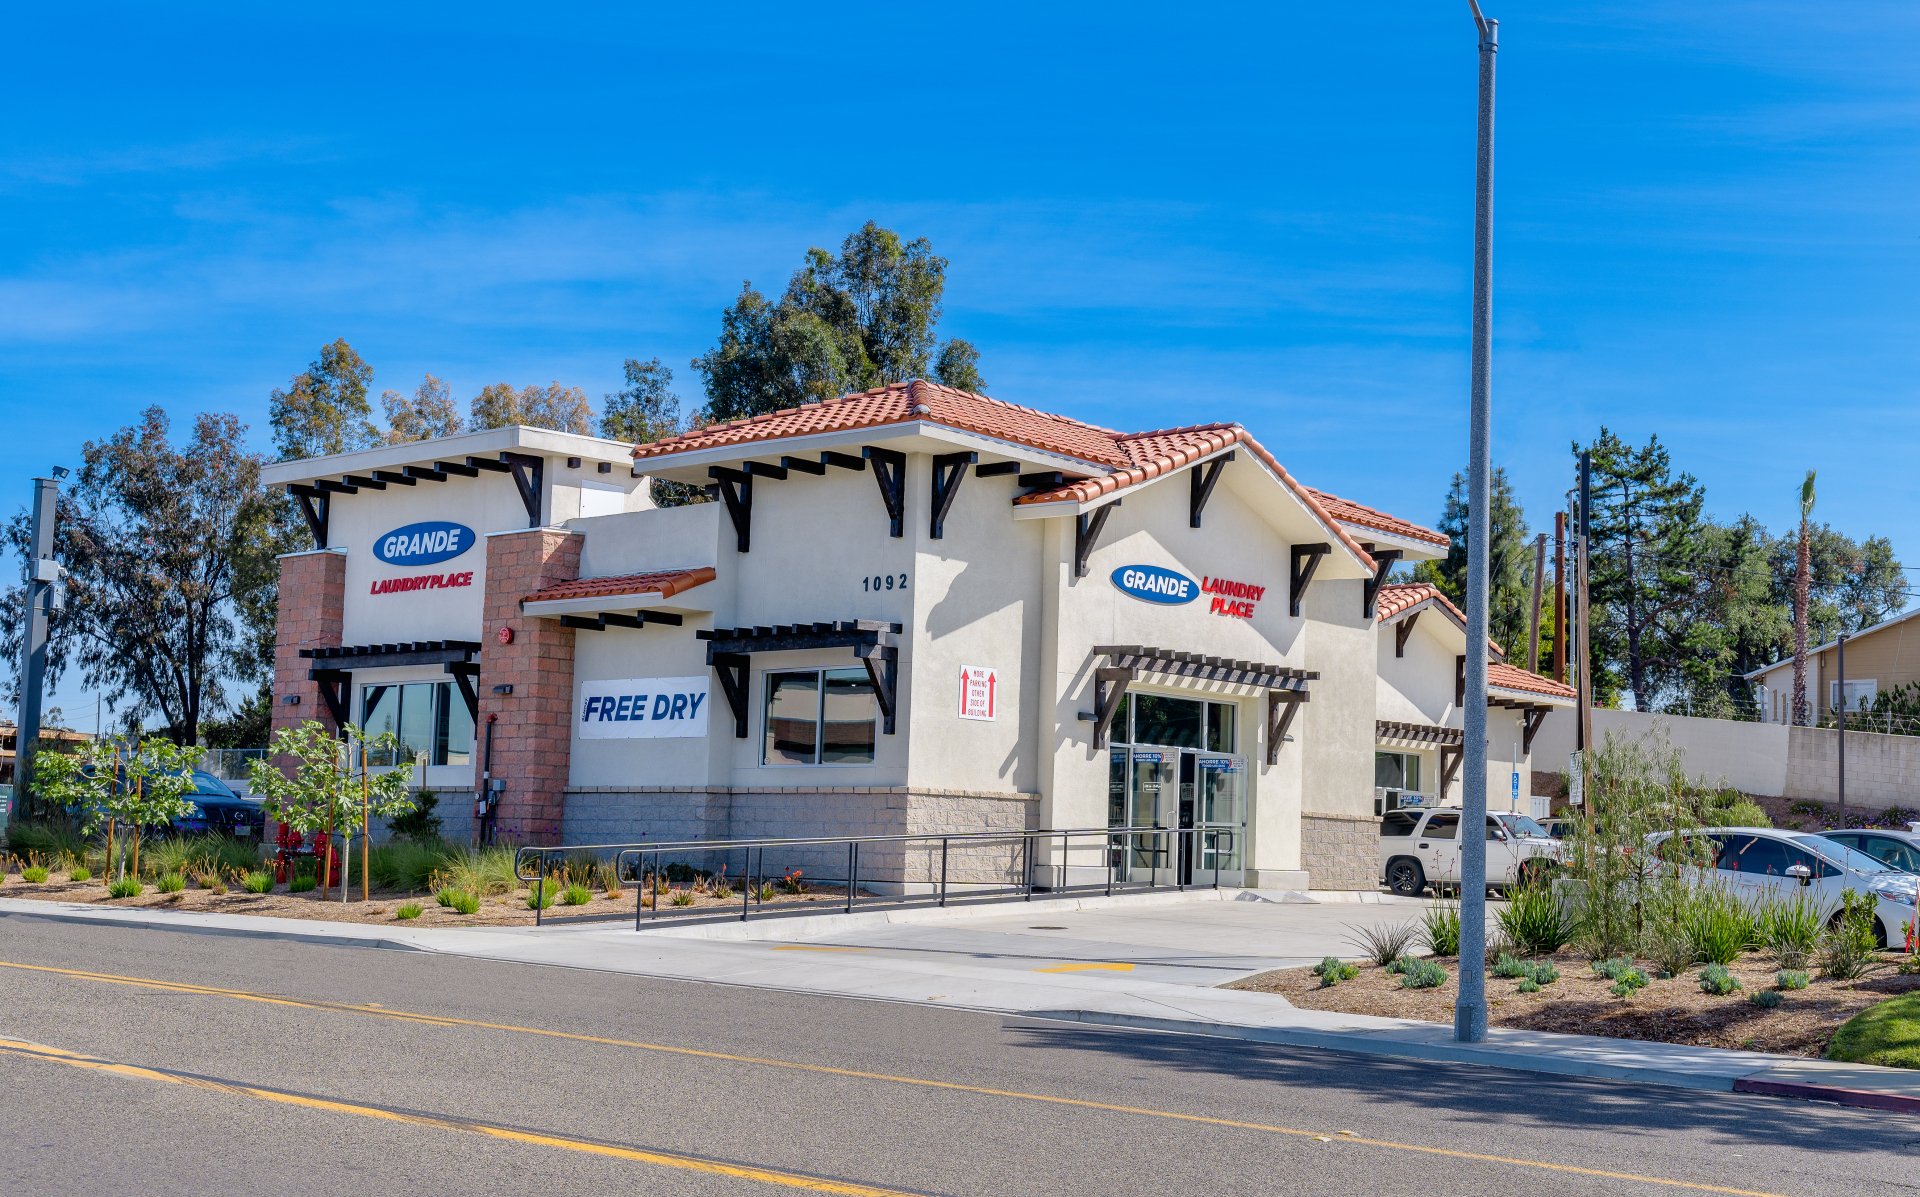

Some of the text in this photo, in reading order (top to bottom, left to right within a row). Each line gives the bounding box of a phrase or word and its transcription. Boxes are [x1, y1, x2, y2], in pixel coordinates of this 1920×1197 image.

[384, 528, 461, 558] GRANDE
[862, 573, 908, 592] 1092
[1123, 569, 1190, 598] GRANDE
[1201, 576, 1266, 601] LAUNDRY
[1210, 597, 1255, 618] PLACE
[969, 679, 988, 688] PARKING
[973, 670, 985, 678] MORE
[970, 698, 985, 708] SIDE OF
[971, 689, 985, 698] OTHER
[583, 694, 649, 722] FREE
[651, 692, 707, 720] DRY
[967, 708, 987, 718] BUILDING
